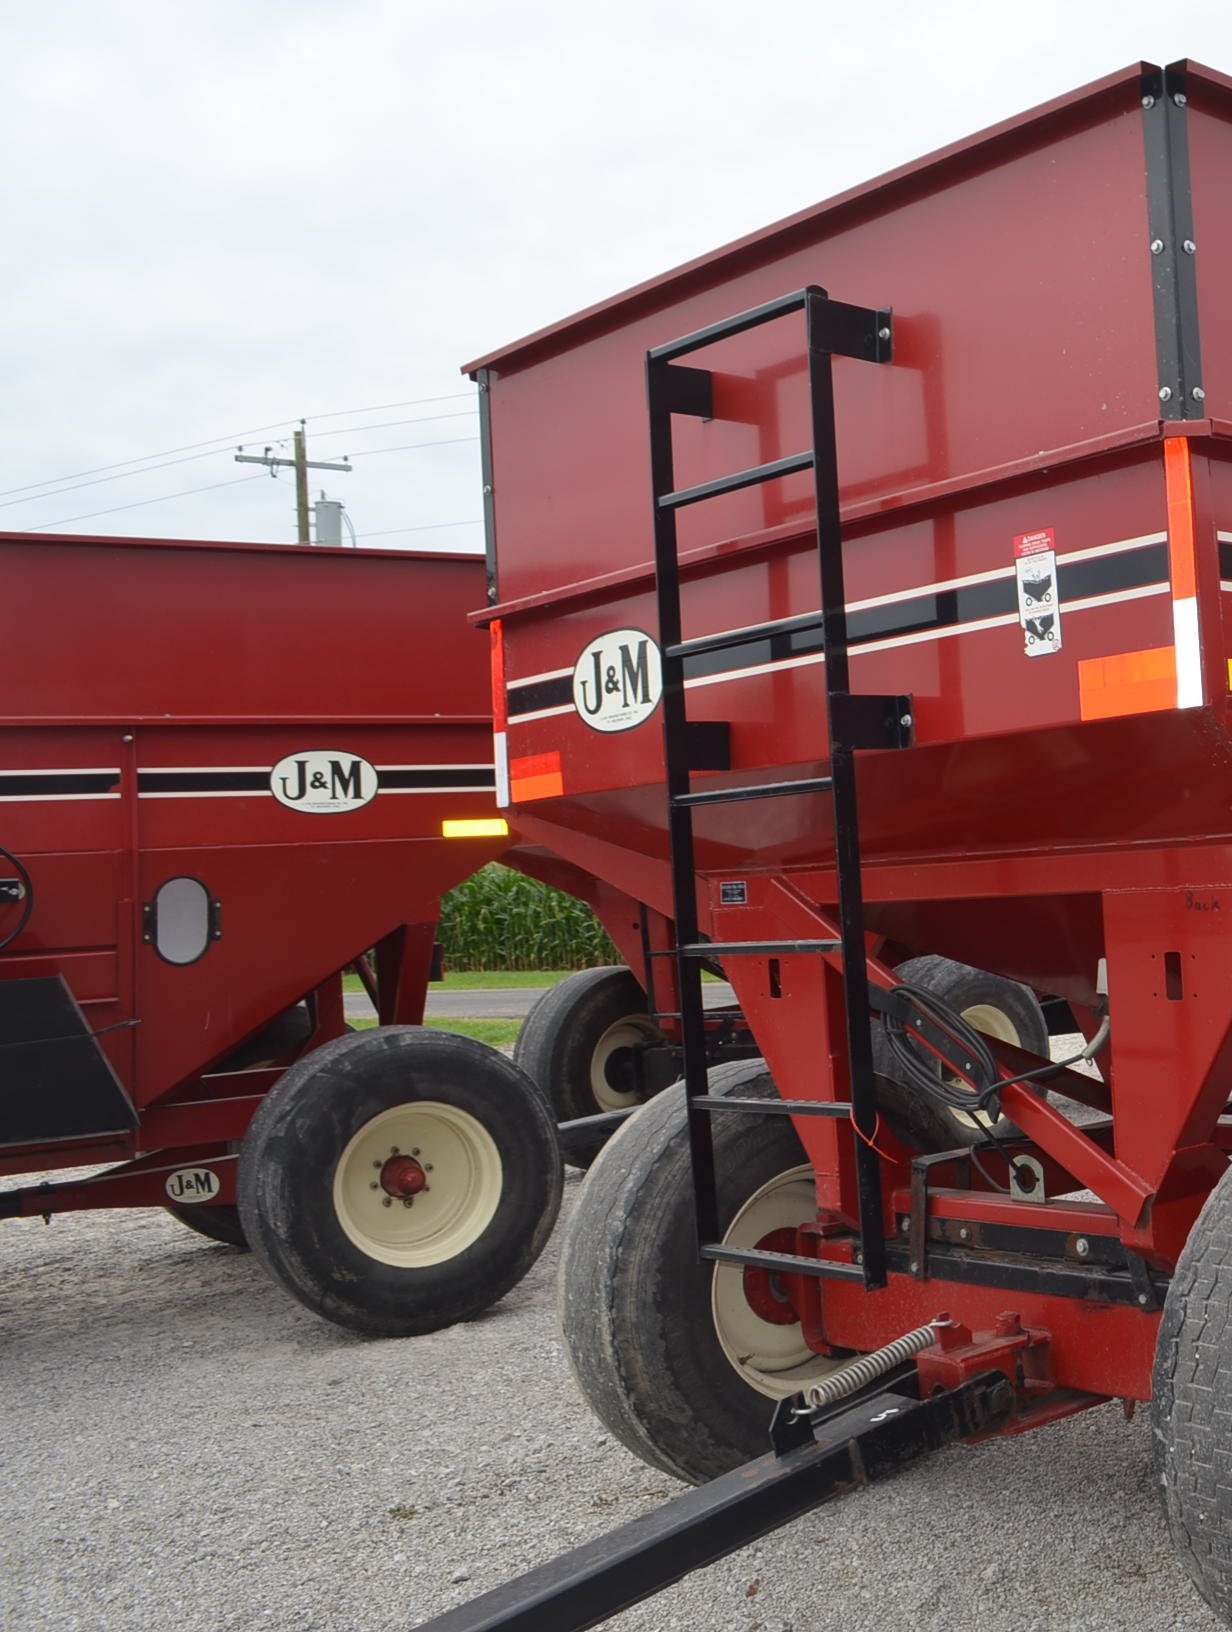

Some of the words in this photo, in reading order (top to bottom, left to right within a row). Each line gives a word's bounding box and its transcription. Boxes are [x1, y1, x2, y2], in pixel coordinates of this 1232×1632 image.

[580, 640, 652, 715] J&M
[279, 759, 366, 801] J&M
[168, 1172, 214, 1197] J&M
